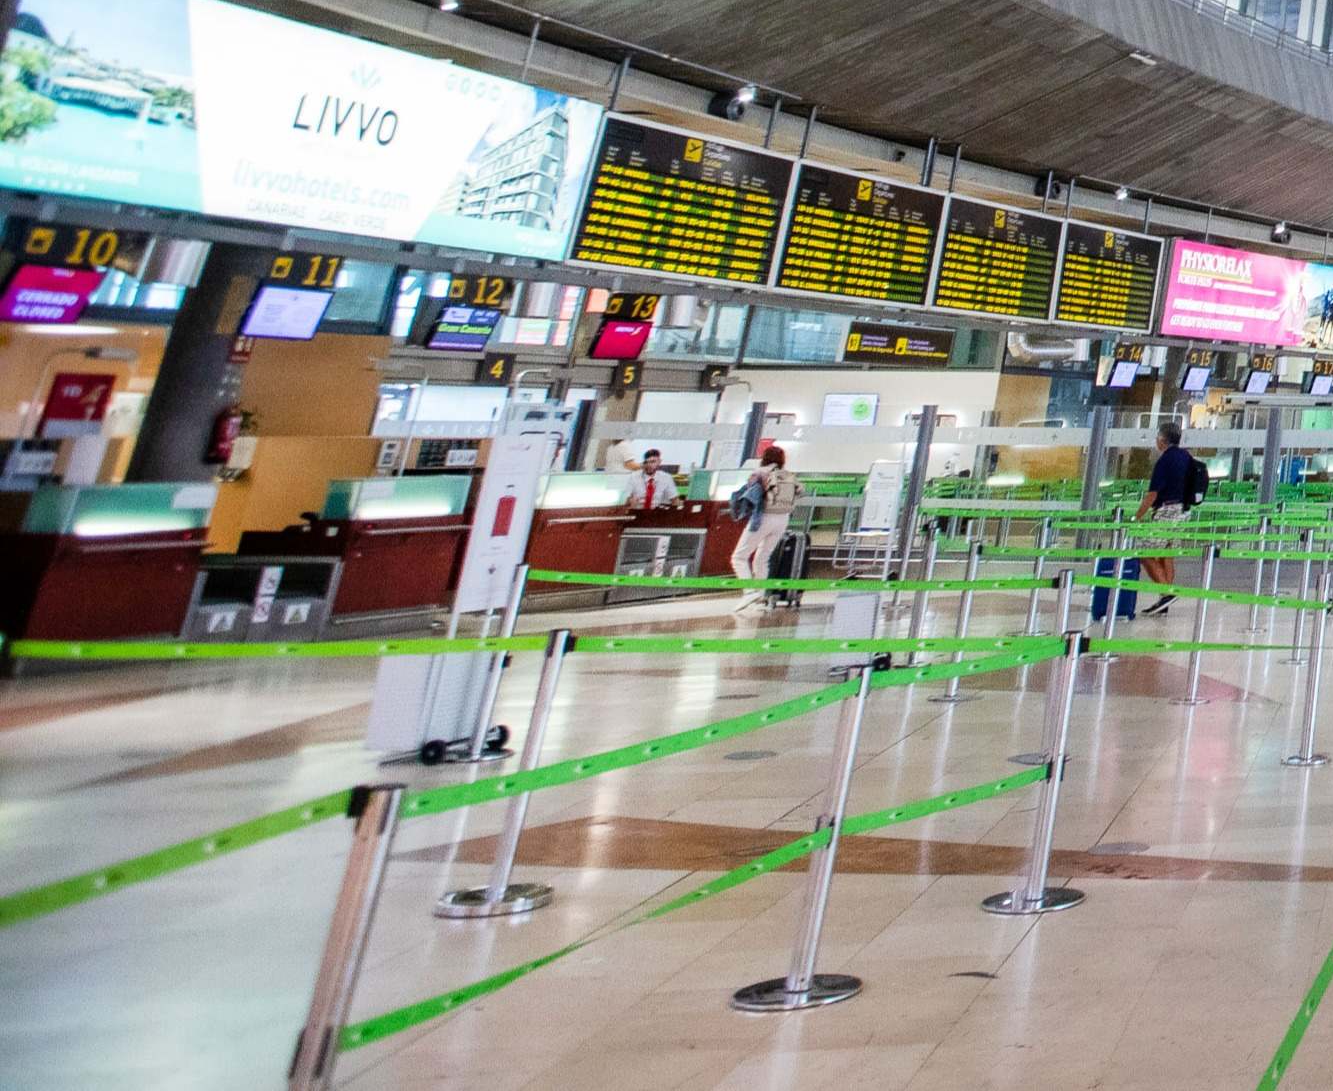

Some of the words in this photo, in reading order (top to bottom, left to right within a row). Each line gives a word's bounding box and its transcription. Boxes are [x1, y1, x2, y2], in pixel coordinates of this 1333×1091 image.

[293, 94, 398, 146] LIVVO
[232, 158, 410, 210] livvohotels.com
[66, 229, 118, 265] 10
[302, 256, 341, 287] 11
[1181, 249, 1253, 279] PHYSIORELAX
[16, 289, 78, 307] CERRADO
[473, 278, 504, 305] 12
[631, 296, 659, 318] 13
[1129, 346, 1142, 362] 14
[1199, 351, 1211, 366] 15
[1261, 357, 1272, 372] 16
[490, 359, 504, 379] 4
[623, 366, 635, 384] 5
